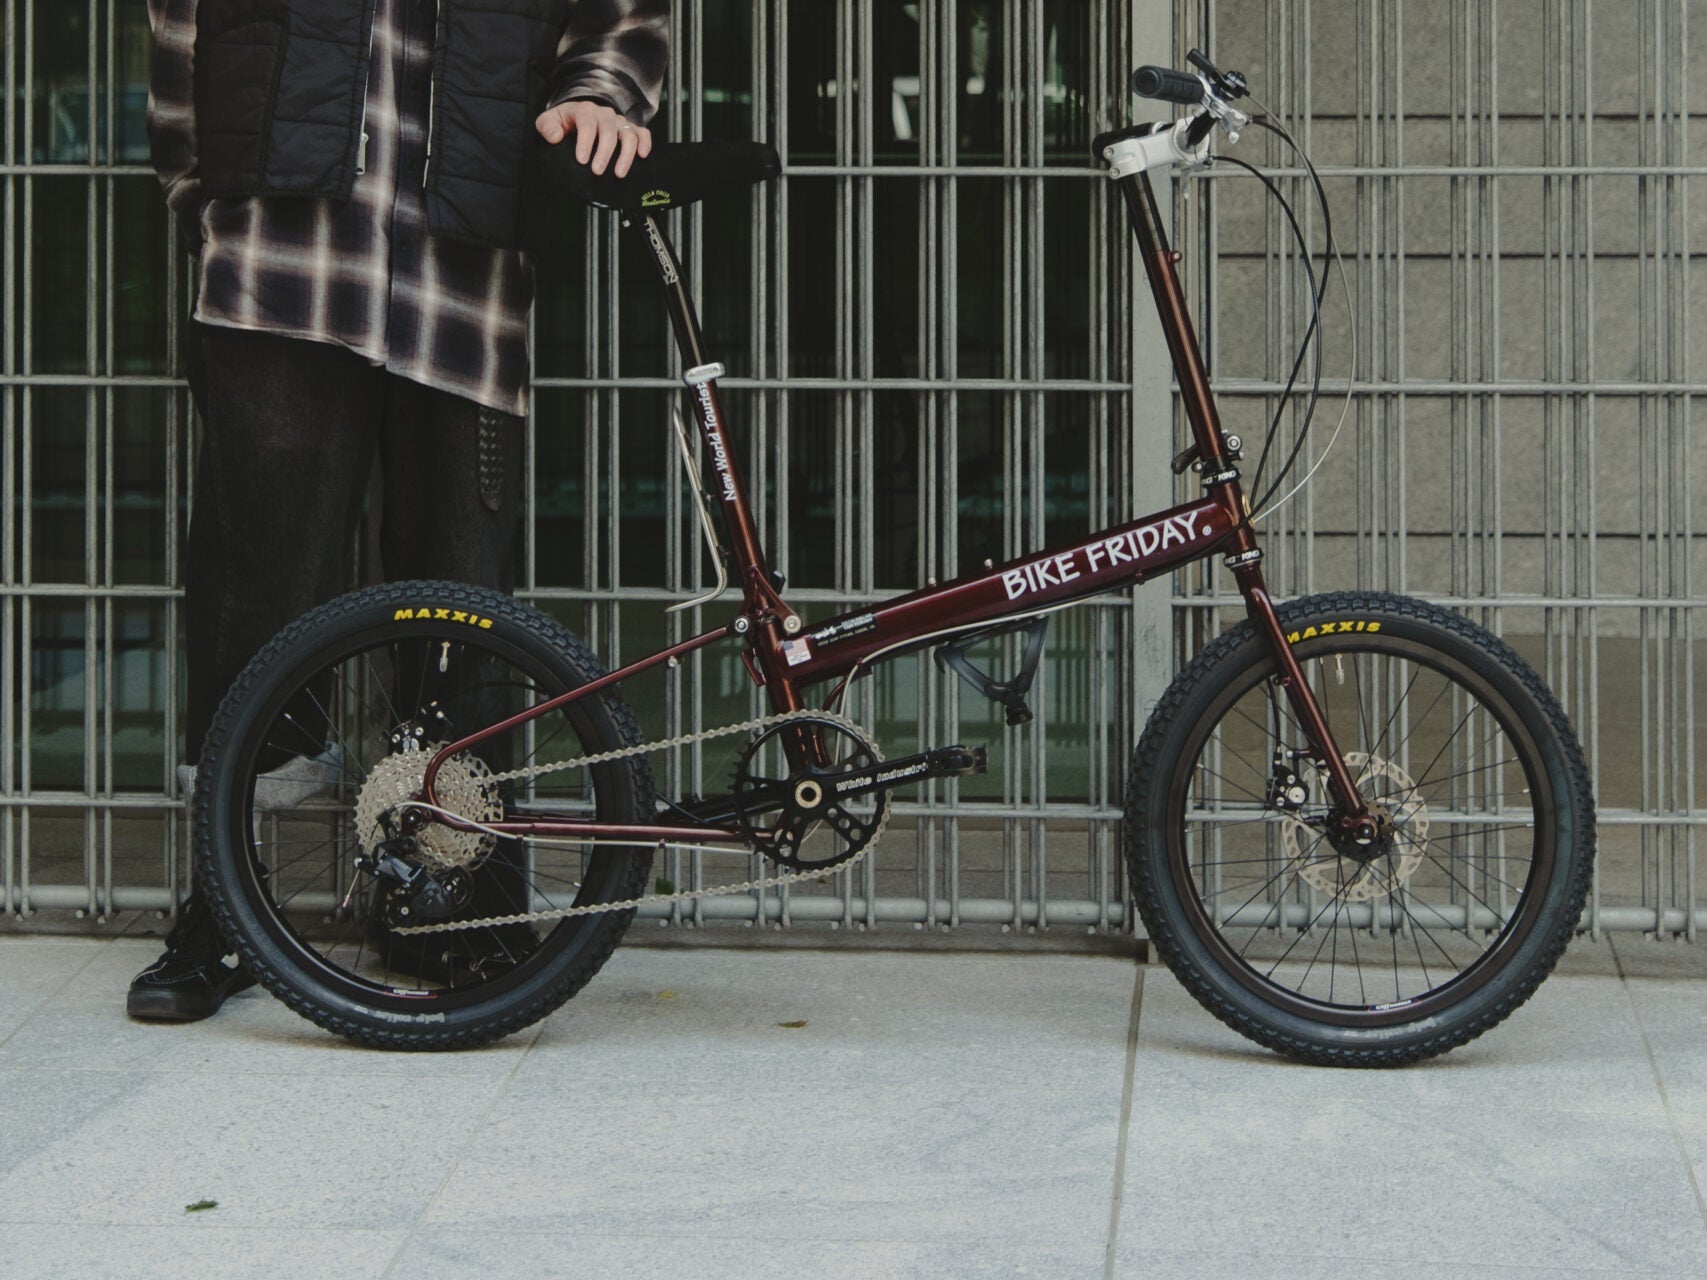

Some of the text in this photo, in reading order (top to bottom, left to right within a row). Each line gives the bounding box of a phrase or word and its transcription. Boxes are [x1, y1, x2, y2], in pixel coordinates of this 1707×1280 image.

[644, 218, 679, 284] THOMSON
[697, 382, 738, 501] New World Tourist
[1001, 552, 1081, 601] BIKE
[393, 607, 494, 629] MAXXIS
[1286, 620, 1381, 645] MAXXIS
[876, 761, 929, 783] Industri
